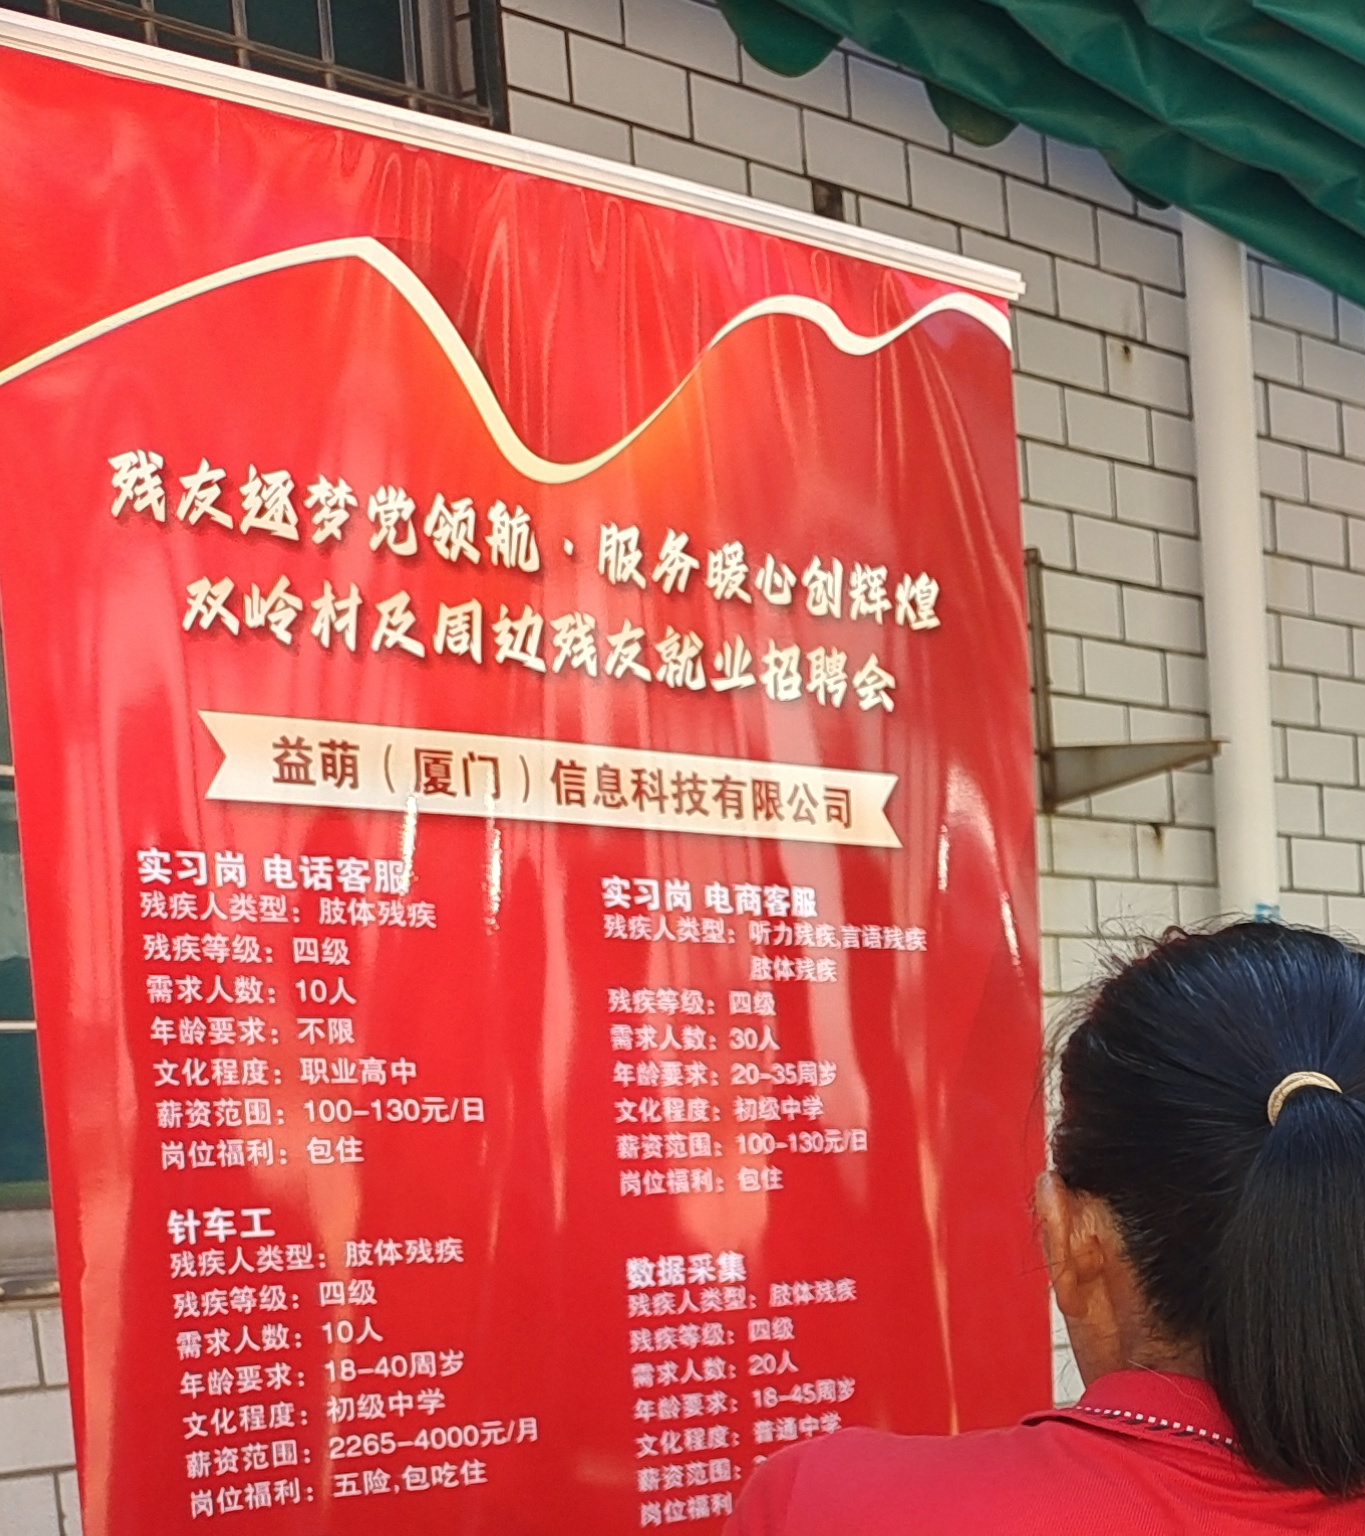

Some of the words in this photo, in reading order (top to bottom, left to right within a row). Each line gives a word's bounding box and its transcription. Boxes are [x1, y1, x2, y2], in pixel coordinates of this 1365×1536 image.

[272, 734, 853, 827] 益萌（厦门）信息科技有限公司
[138, 848, 247, 888] 实习岗
[263, 853, 410, 896] 电话客服
[140, 891, 438, 929] 残疾人类型：肢体残疾
[601, 875, 692, 912] 实习岗
[704, 881, 818, 918] 电商客服
[144, 933, 352, 966] 残疾等级：四级
[750, 955, 838, 983] 肢体残疾
[146, 974, 357, 1005] 需求人数：10人
[608, 988, 777, 1017] 残疾等级：四级
[150, 1016, 356, 1047] 年龄要求：不限
[610, 1024, 781, 1052] 需求人数：30人
[153, 1057, 418, 1088] 文化程度：职业高中
[614, 1096, 824, 1124] 文化程度：初级中学
[160, 1136, 365, 1171] 岗位福利：包住
[620, 1166, 785, 1197] 岗位福利：包住
[167, 1206, 276, 1246] 针车工
[170, 1236, 465, 1279] 残疾人类型：肢体残疾
[626, 1250, 747, 1290] 数据采集
[173, 1279, 378, 1319] 残疾等级：四级
[628, 1277, 858, 1319] 残疾人类型：肢体残疾
[176, 1316, 384, 1361] 需求人数：10人
[629, 1316, 796, 1354] 残疾等级：四级
[631, 1348, 799, 1389] 需求人数：20人
[183, 1387, 446, 1440] 文化程度：初级中学
[637, 1455, 769, 1493] 薪资范围：
